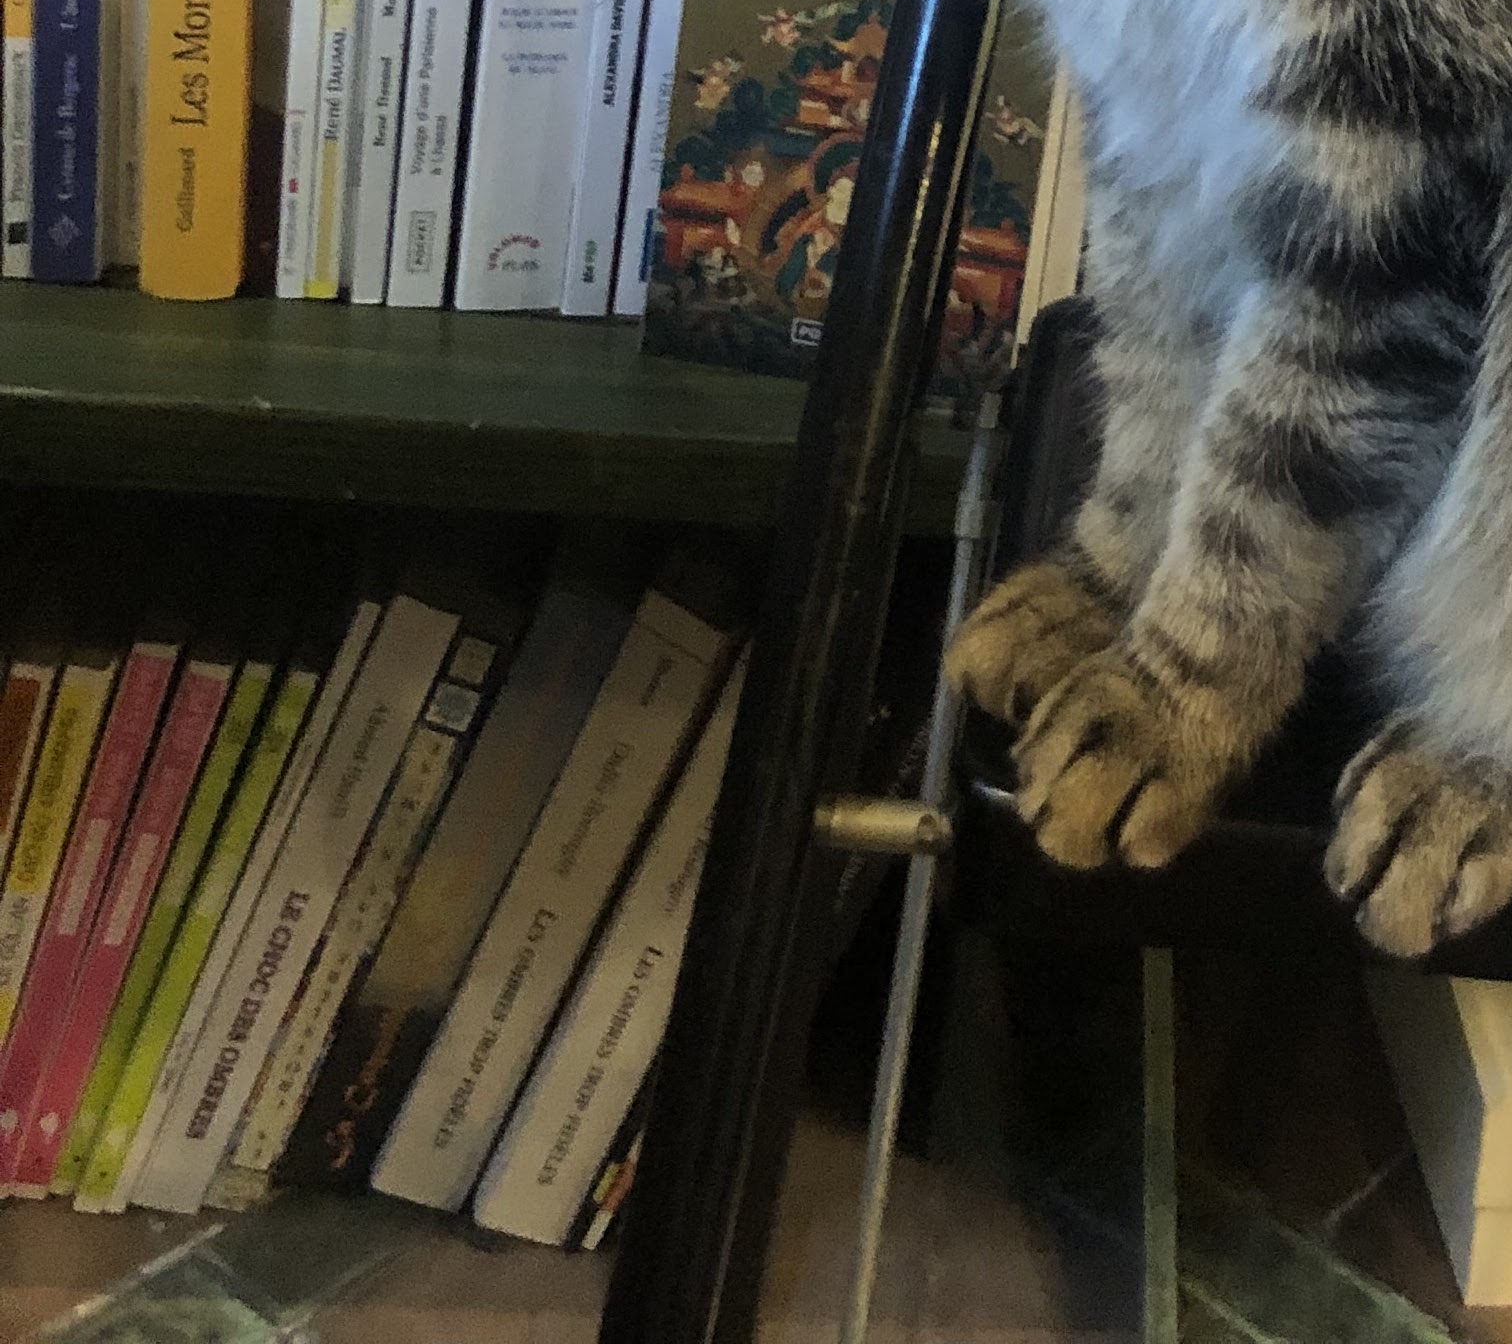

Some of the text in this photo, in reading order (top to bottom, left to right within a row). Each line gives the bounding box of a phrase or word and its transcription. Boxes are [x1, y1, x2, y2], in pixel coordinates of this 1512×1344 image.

[170, 71, 210, 127] Les
[604, 34, 622, 106] ALEXANDRA
[325, 95, 341, 142] René
[176, 147, 196, 234] Gallimard
